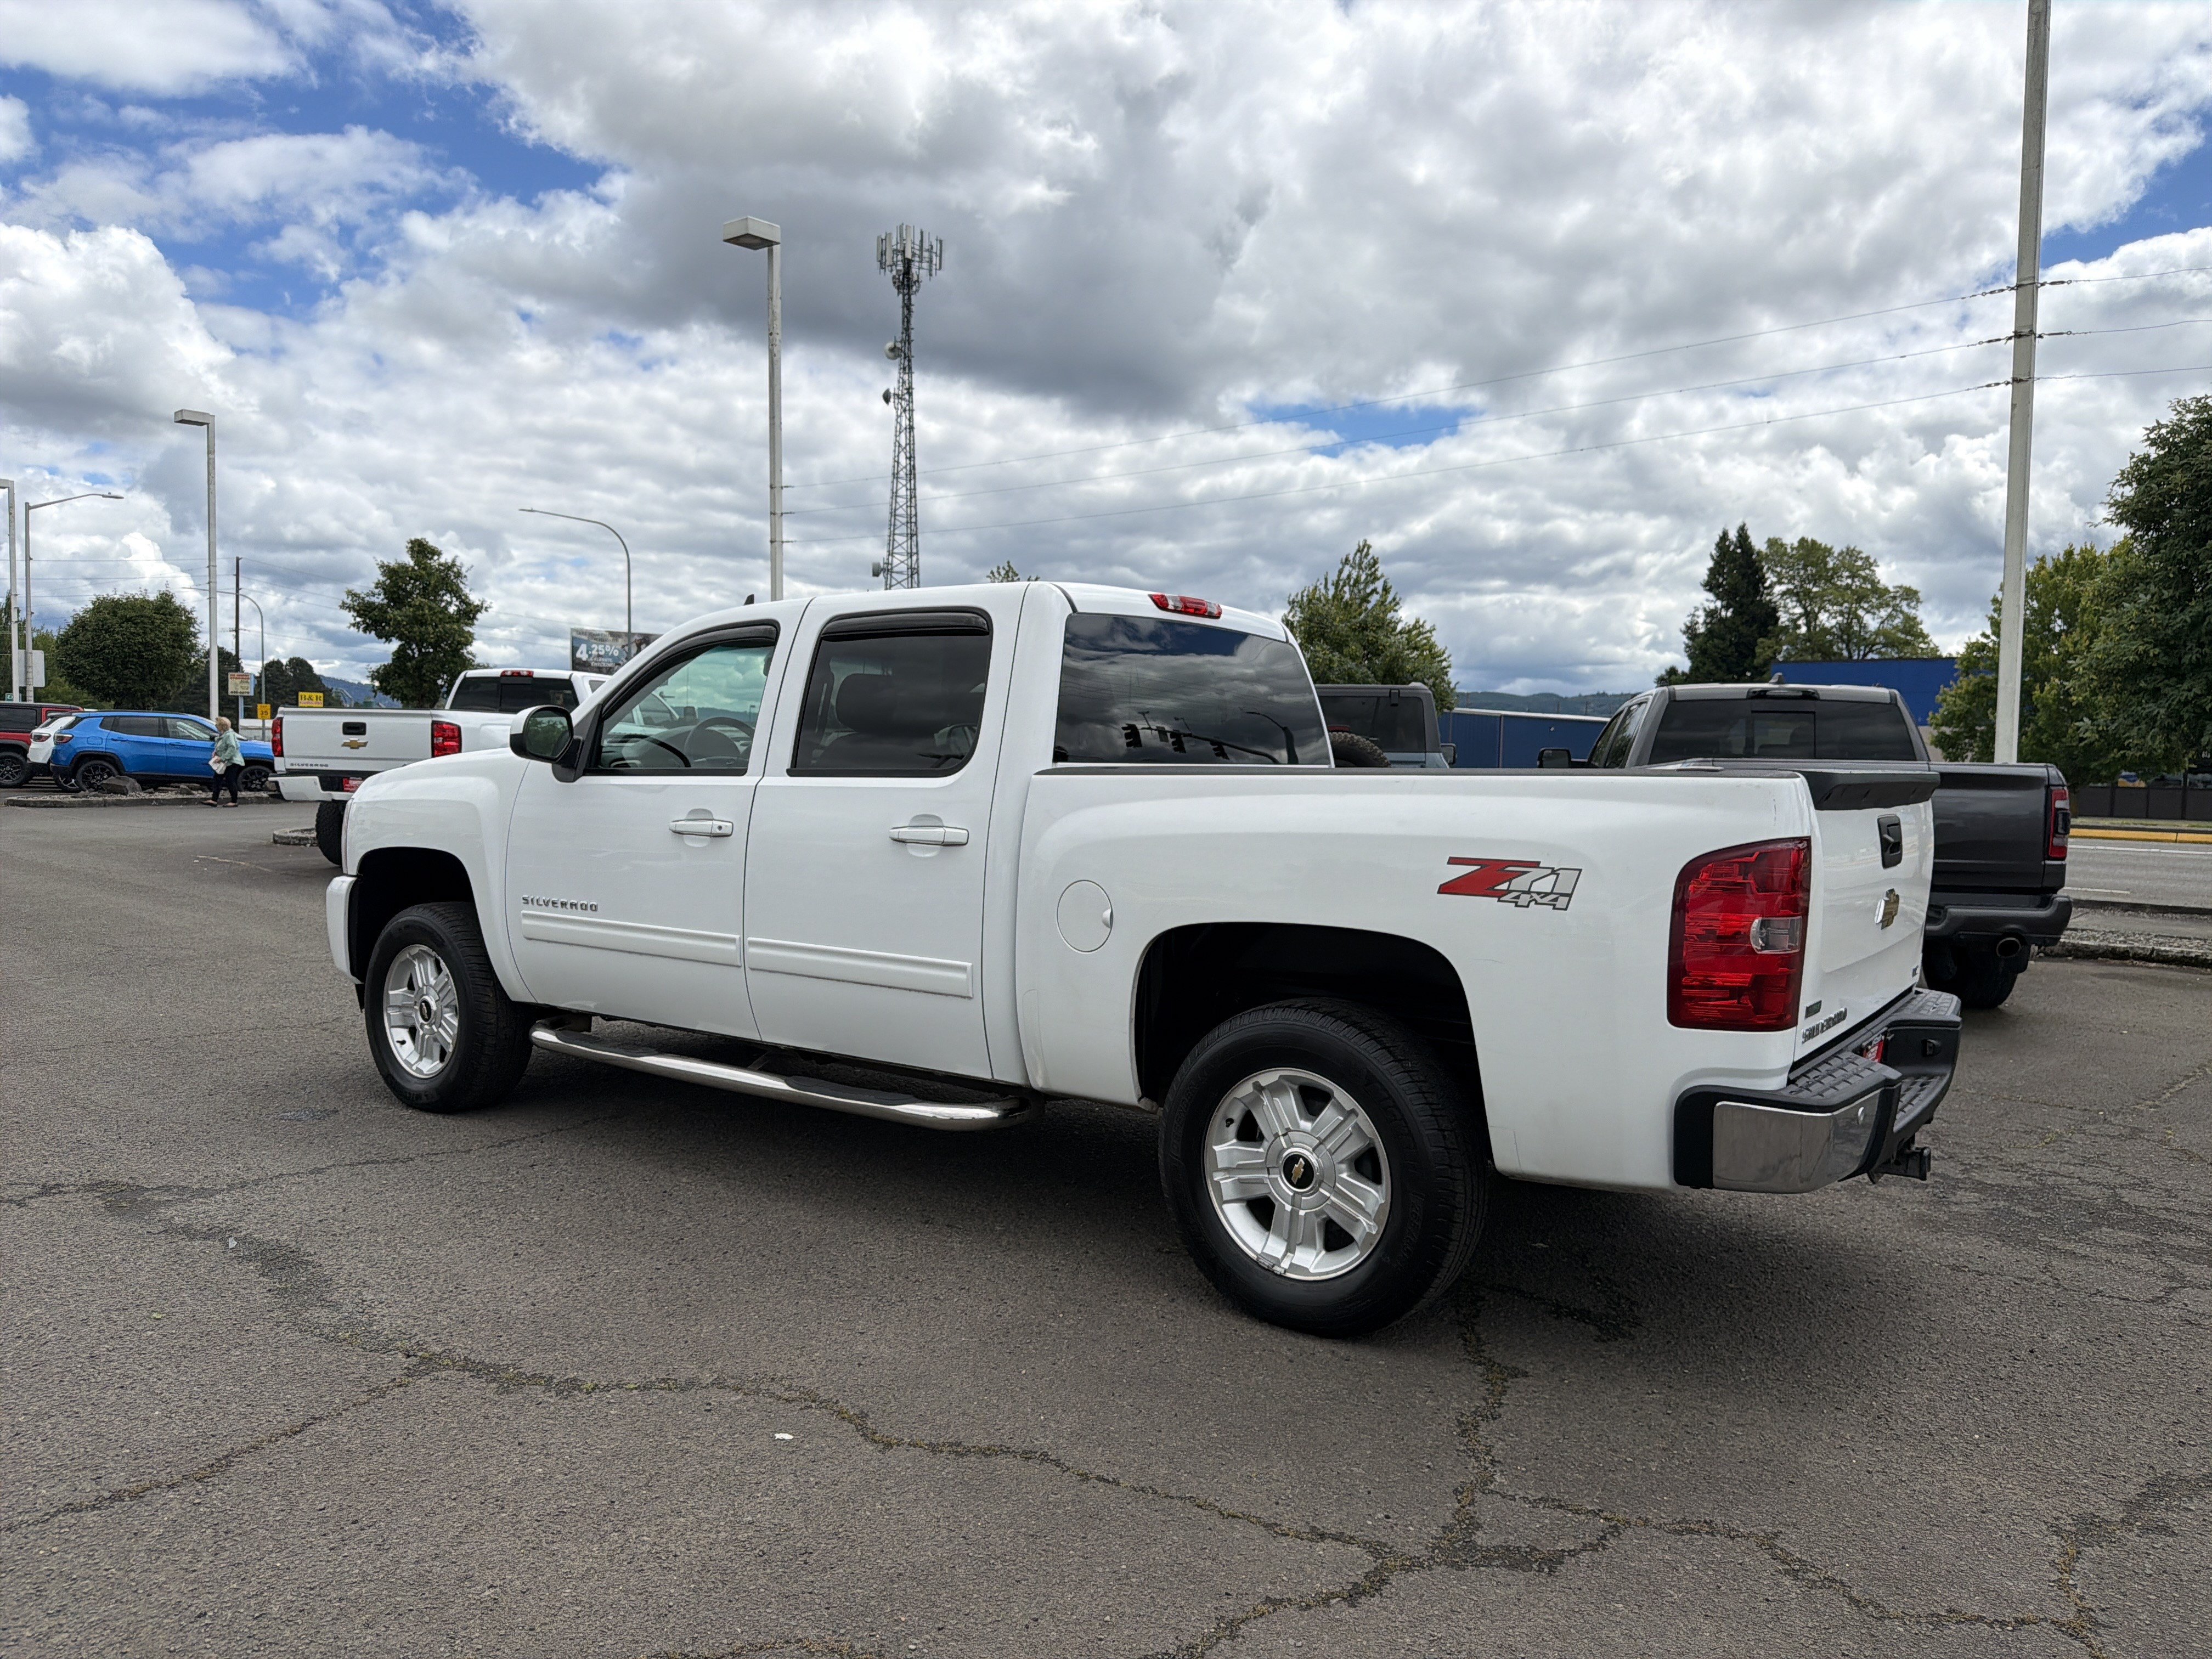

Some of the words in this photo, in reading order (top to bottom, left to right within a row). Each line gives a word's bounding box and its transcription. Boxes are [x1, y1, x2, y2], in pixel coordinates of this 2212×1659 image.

[576, 644, 619, 662] 4.25%
[1437, 856, 1582, 898] Z71
[522, 895, 599, 912] SILVERADO
